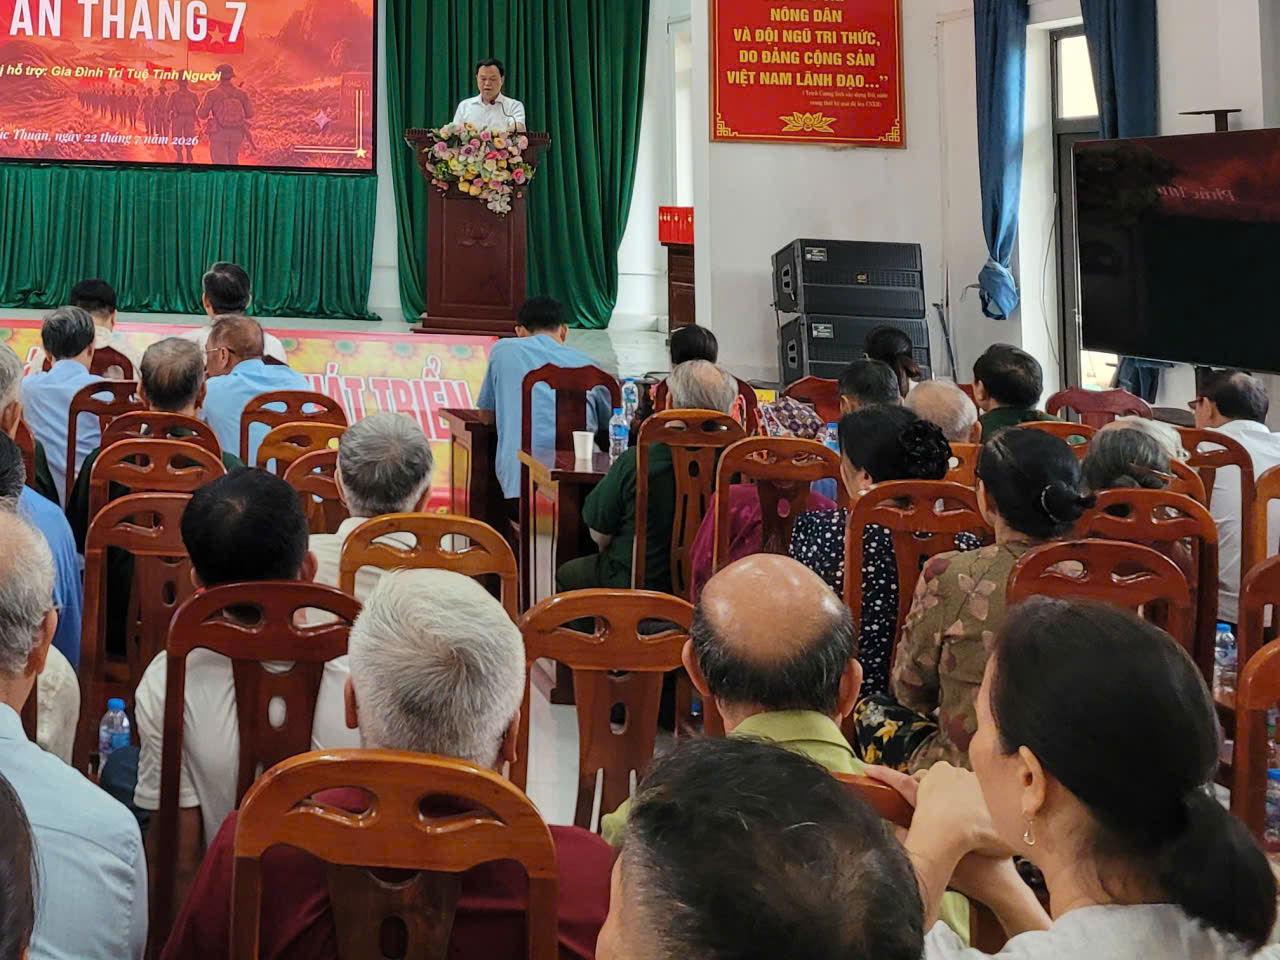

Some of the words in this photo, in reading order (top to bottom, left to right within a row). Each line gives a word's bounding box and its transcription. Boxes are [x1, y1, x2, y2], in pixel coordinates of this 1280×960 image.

[225, 1, 247, 43] 7
[771, 6, 809, 22] NÔNG
[814, 8, 842, 22] DÂN
[734, 26, 751, 41] VÀ
[756, 27, 778, 45] ĐỘI
[740, 50, 758, 63] DO
[804, 50, 842, 67] CỘNG
[847, 50, 875, 66] SẢN
[51, 66, 72, 77] Gia
[182, 70, 222, 84] Người
[727, 69, 756, 87] VIỆT
[760, 72, 792, 85] NAM
[55, 131, 81, 145] ngày
[84, 133, 97, 142] 22
[100, 130, 132, 145] tháng
[144, 132, 169, 144] năm
[171, 134, 199, 146] 2026
